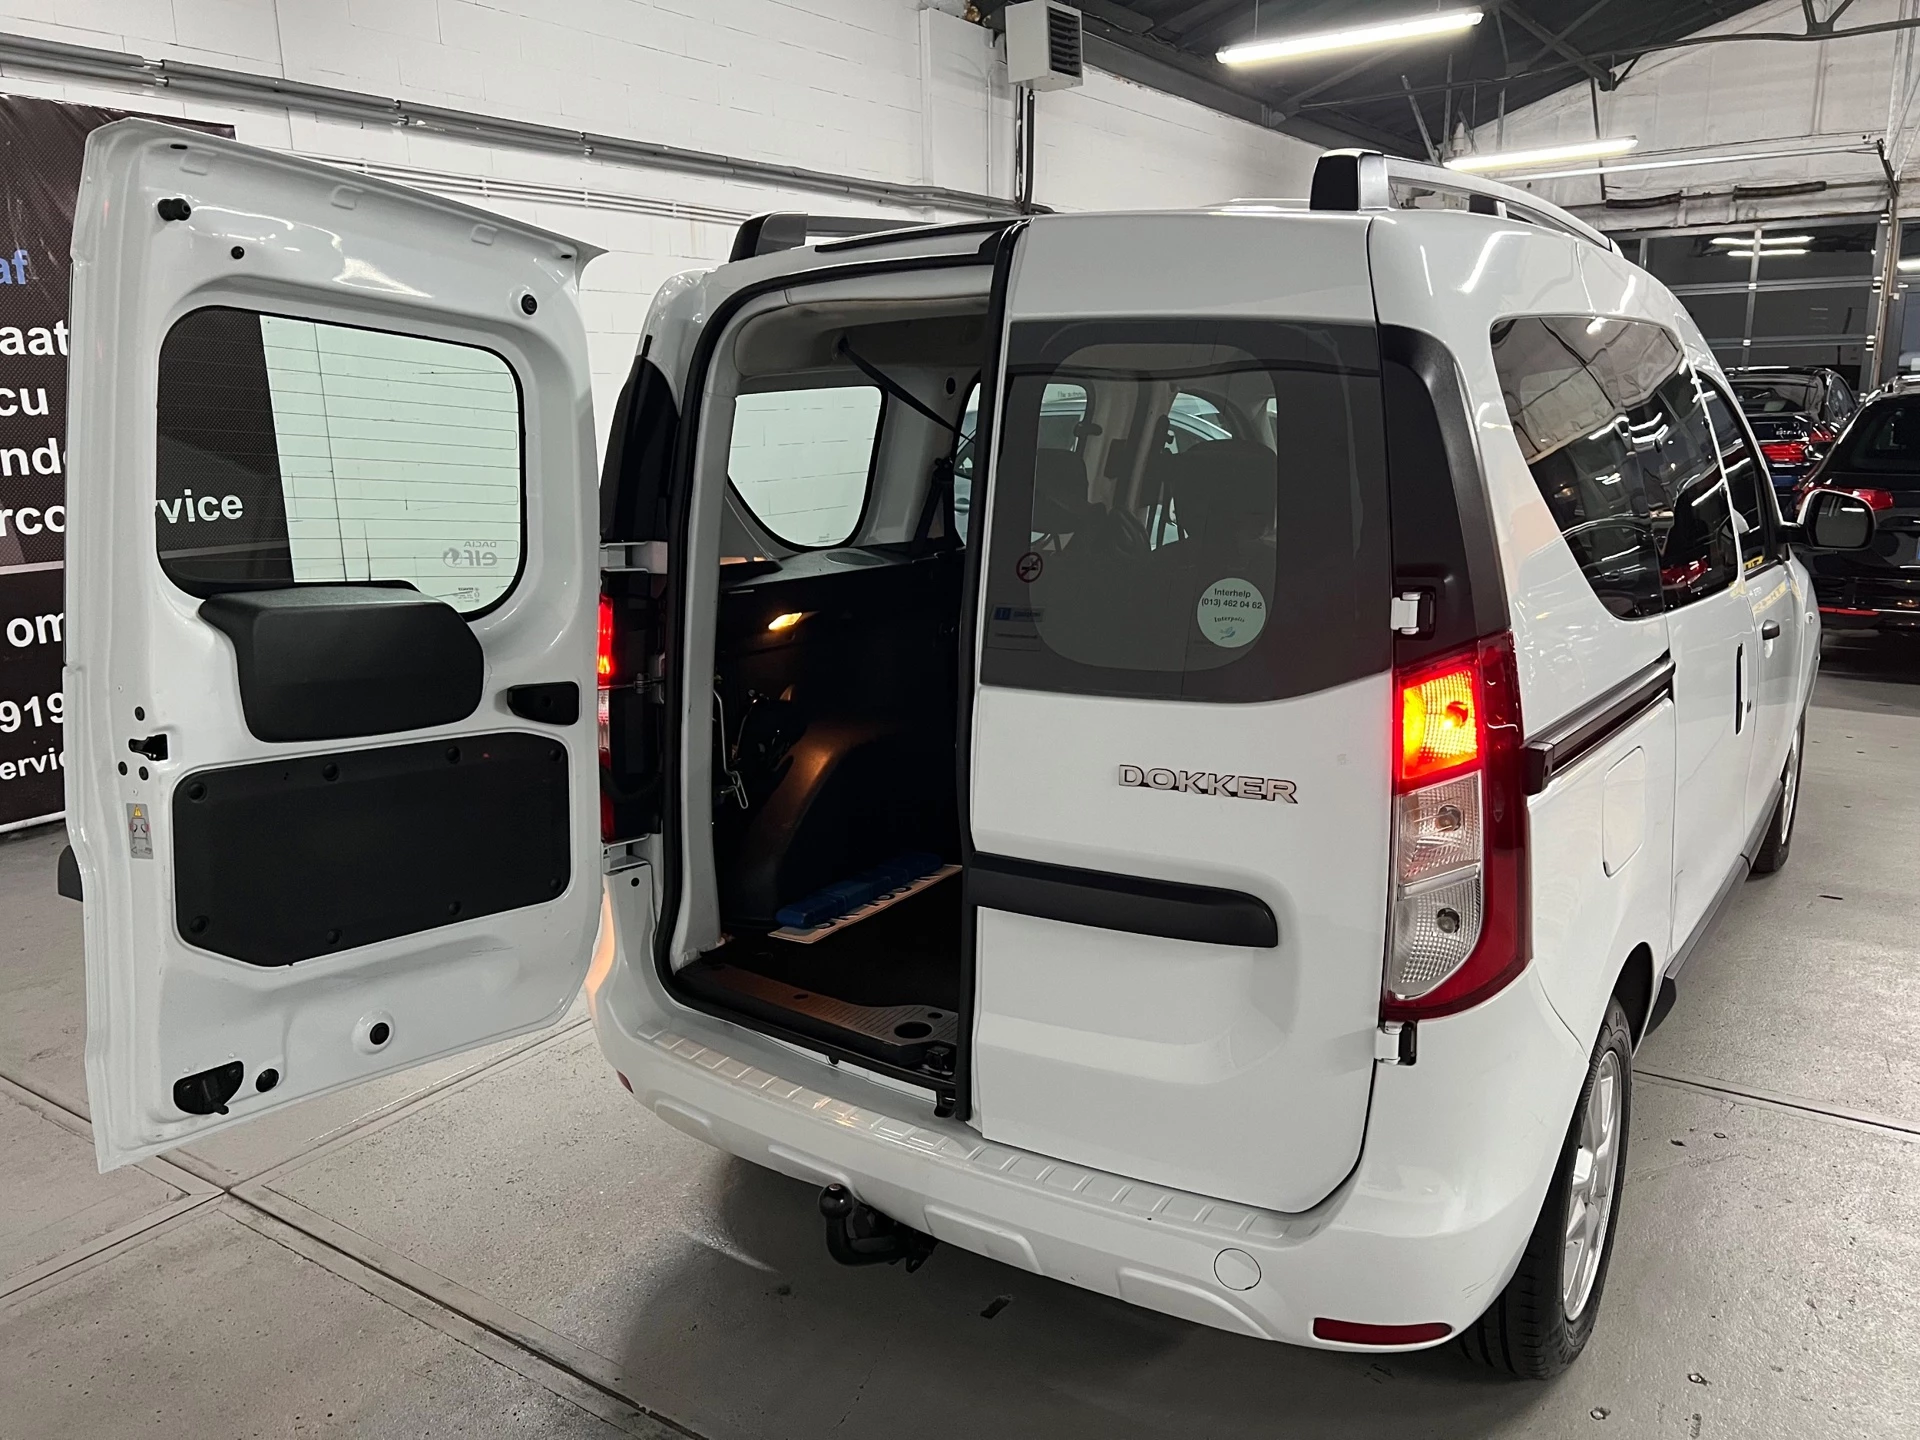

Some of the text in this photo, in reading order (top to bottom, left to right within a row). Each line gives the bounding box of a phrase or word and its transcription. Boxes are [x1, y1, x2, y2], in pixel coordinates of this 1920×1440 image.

[0, 320, 68, 356] aat
[0, 388, 49, 416] cu
[0, 438, 66, 476] nd
[156, 489, 243, 523] vice
[1201, 598, 1221, 607] (013)
[1214, 588, 1251, 598] Interhelp
[0, 747, 64, 780] ervi
[1118, 764, 1299, 804] DOKKER
